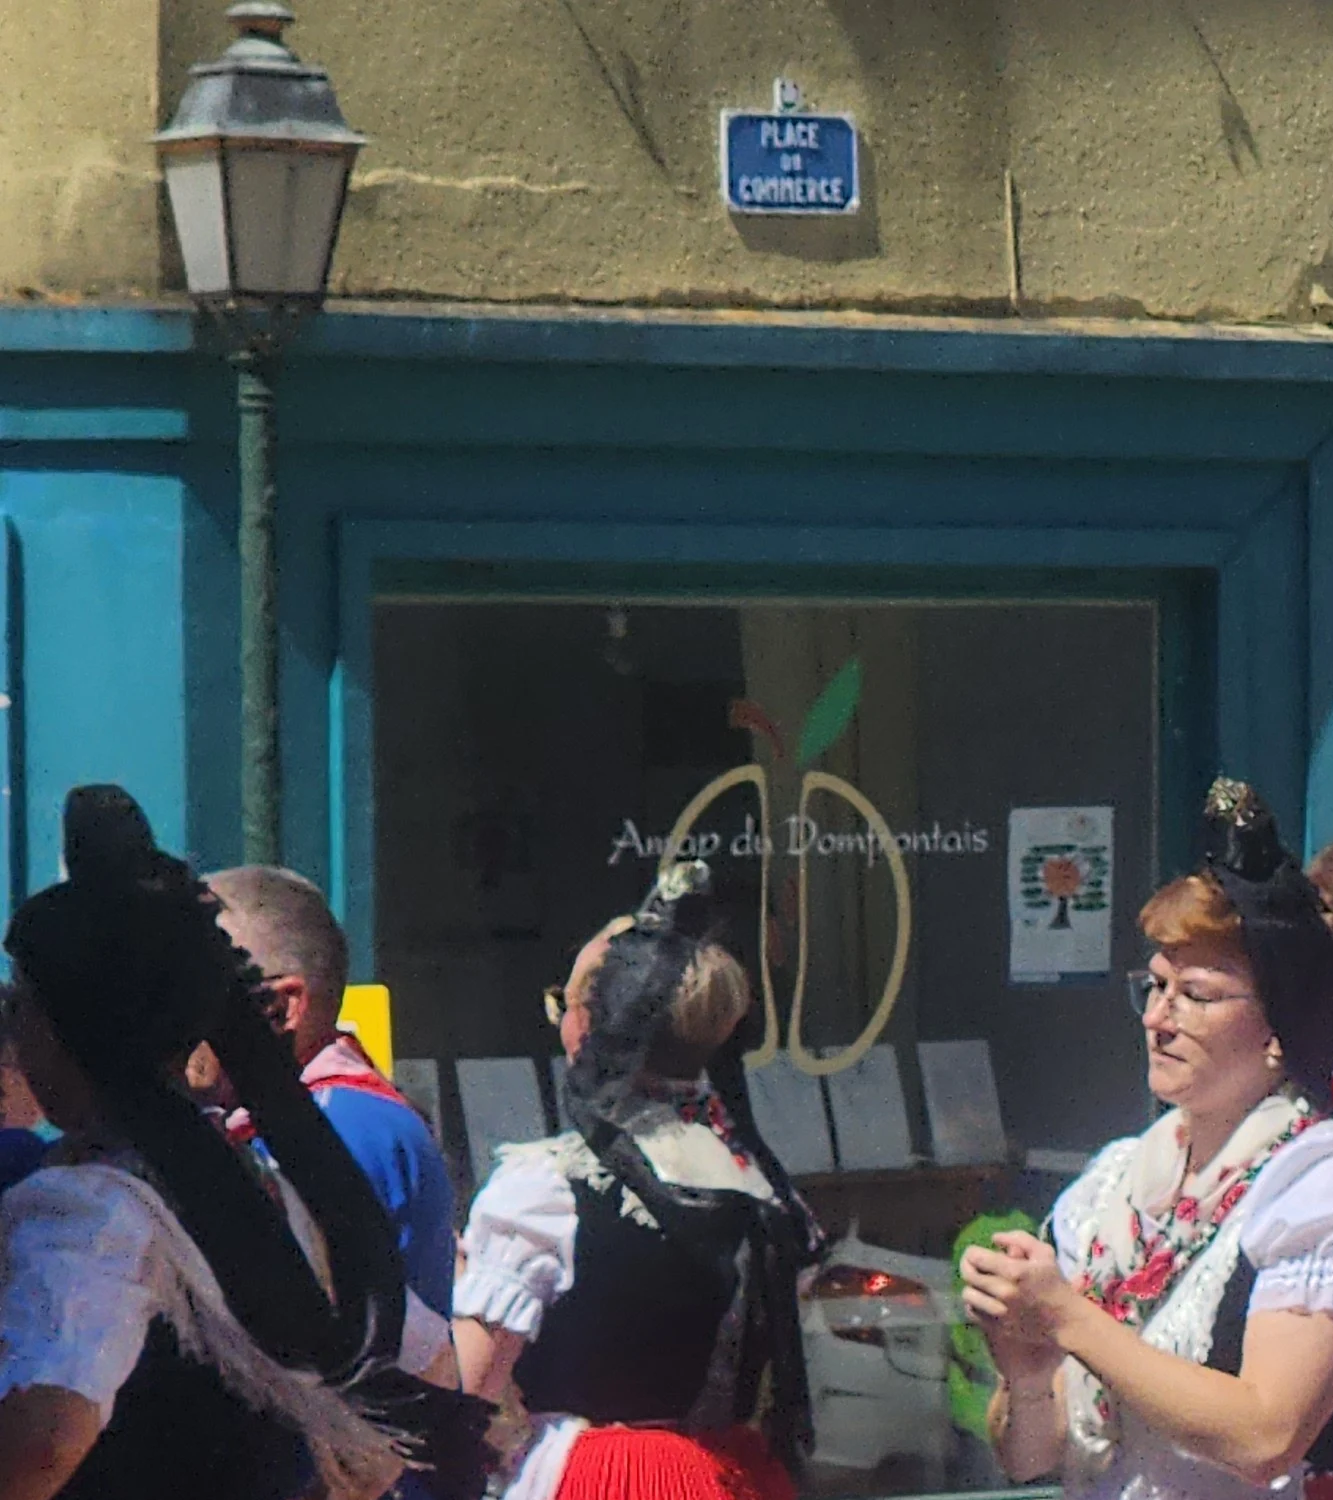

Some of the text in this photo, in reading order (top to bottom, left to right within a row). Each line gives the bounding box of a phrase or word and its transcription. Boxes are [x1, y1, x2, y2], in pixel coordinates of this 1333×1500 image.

[760, 121, 820, 148] PLACE
[739, 176, 845, 204] COMMERCE
[729, 813, 772, 857] du
